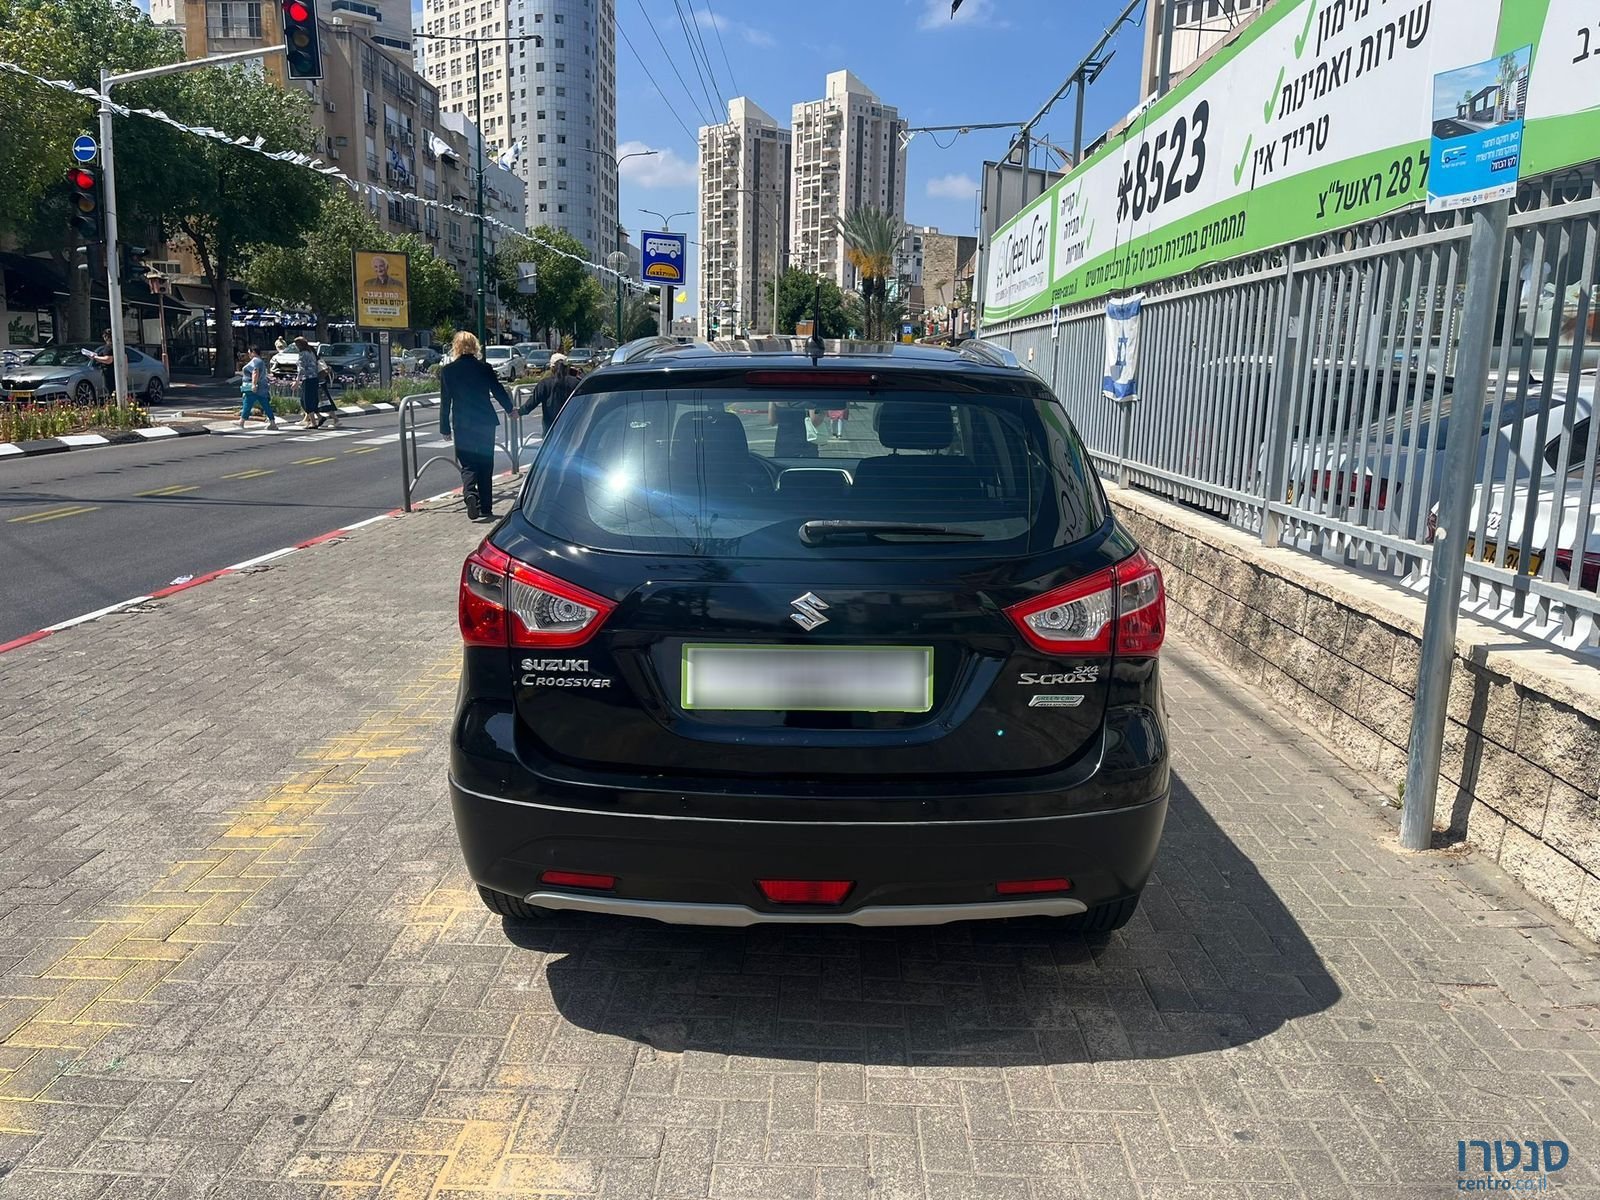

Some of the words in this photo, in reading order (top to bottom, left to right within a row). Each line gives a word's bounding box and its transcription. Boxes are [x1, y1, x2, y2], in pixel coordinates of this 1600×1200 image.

[1355, 0, 1432, 79] שירות
[1279, 46, 1353, 120] ואמינות
[1282, 114, 1330, 167] טרייד
[1250, 140, 1277, 191] אין
[1386, 156, 1413, 199] 28
[1316, 173, 1383, 219] ראשל"צ
[1030, 214, 1049, 266] Car
[1163, 230, 1198, 264] במכירת
[1200, 210, 1246, 250] מתמחים
[1148, 244, 1163, 269] רכבי
[521, 658, 589, 671] SUZUKI
[1017, 673, 1098, 685] S-CROSS
[1073, 665, 1099, 674] SX4
